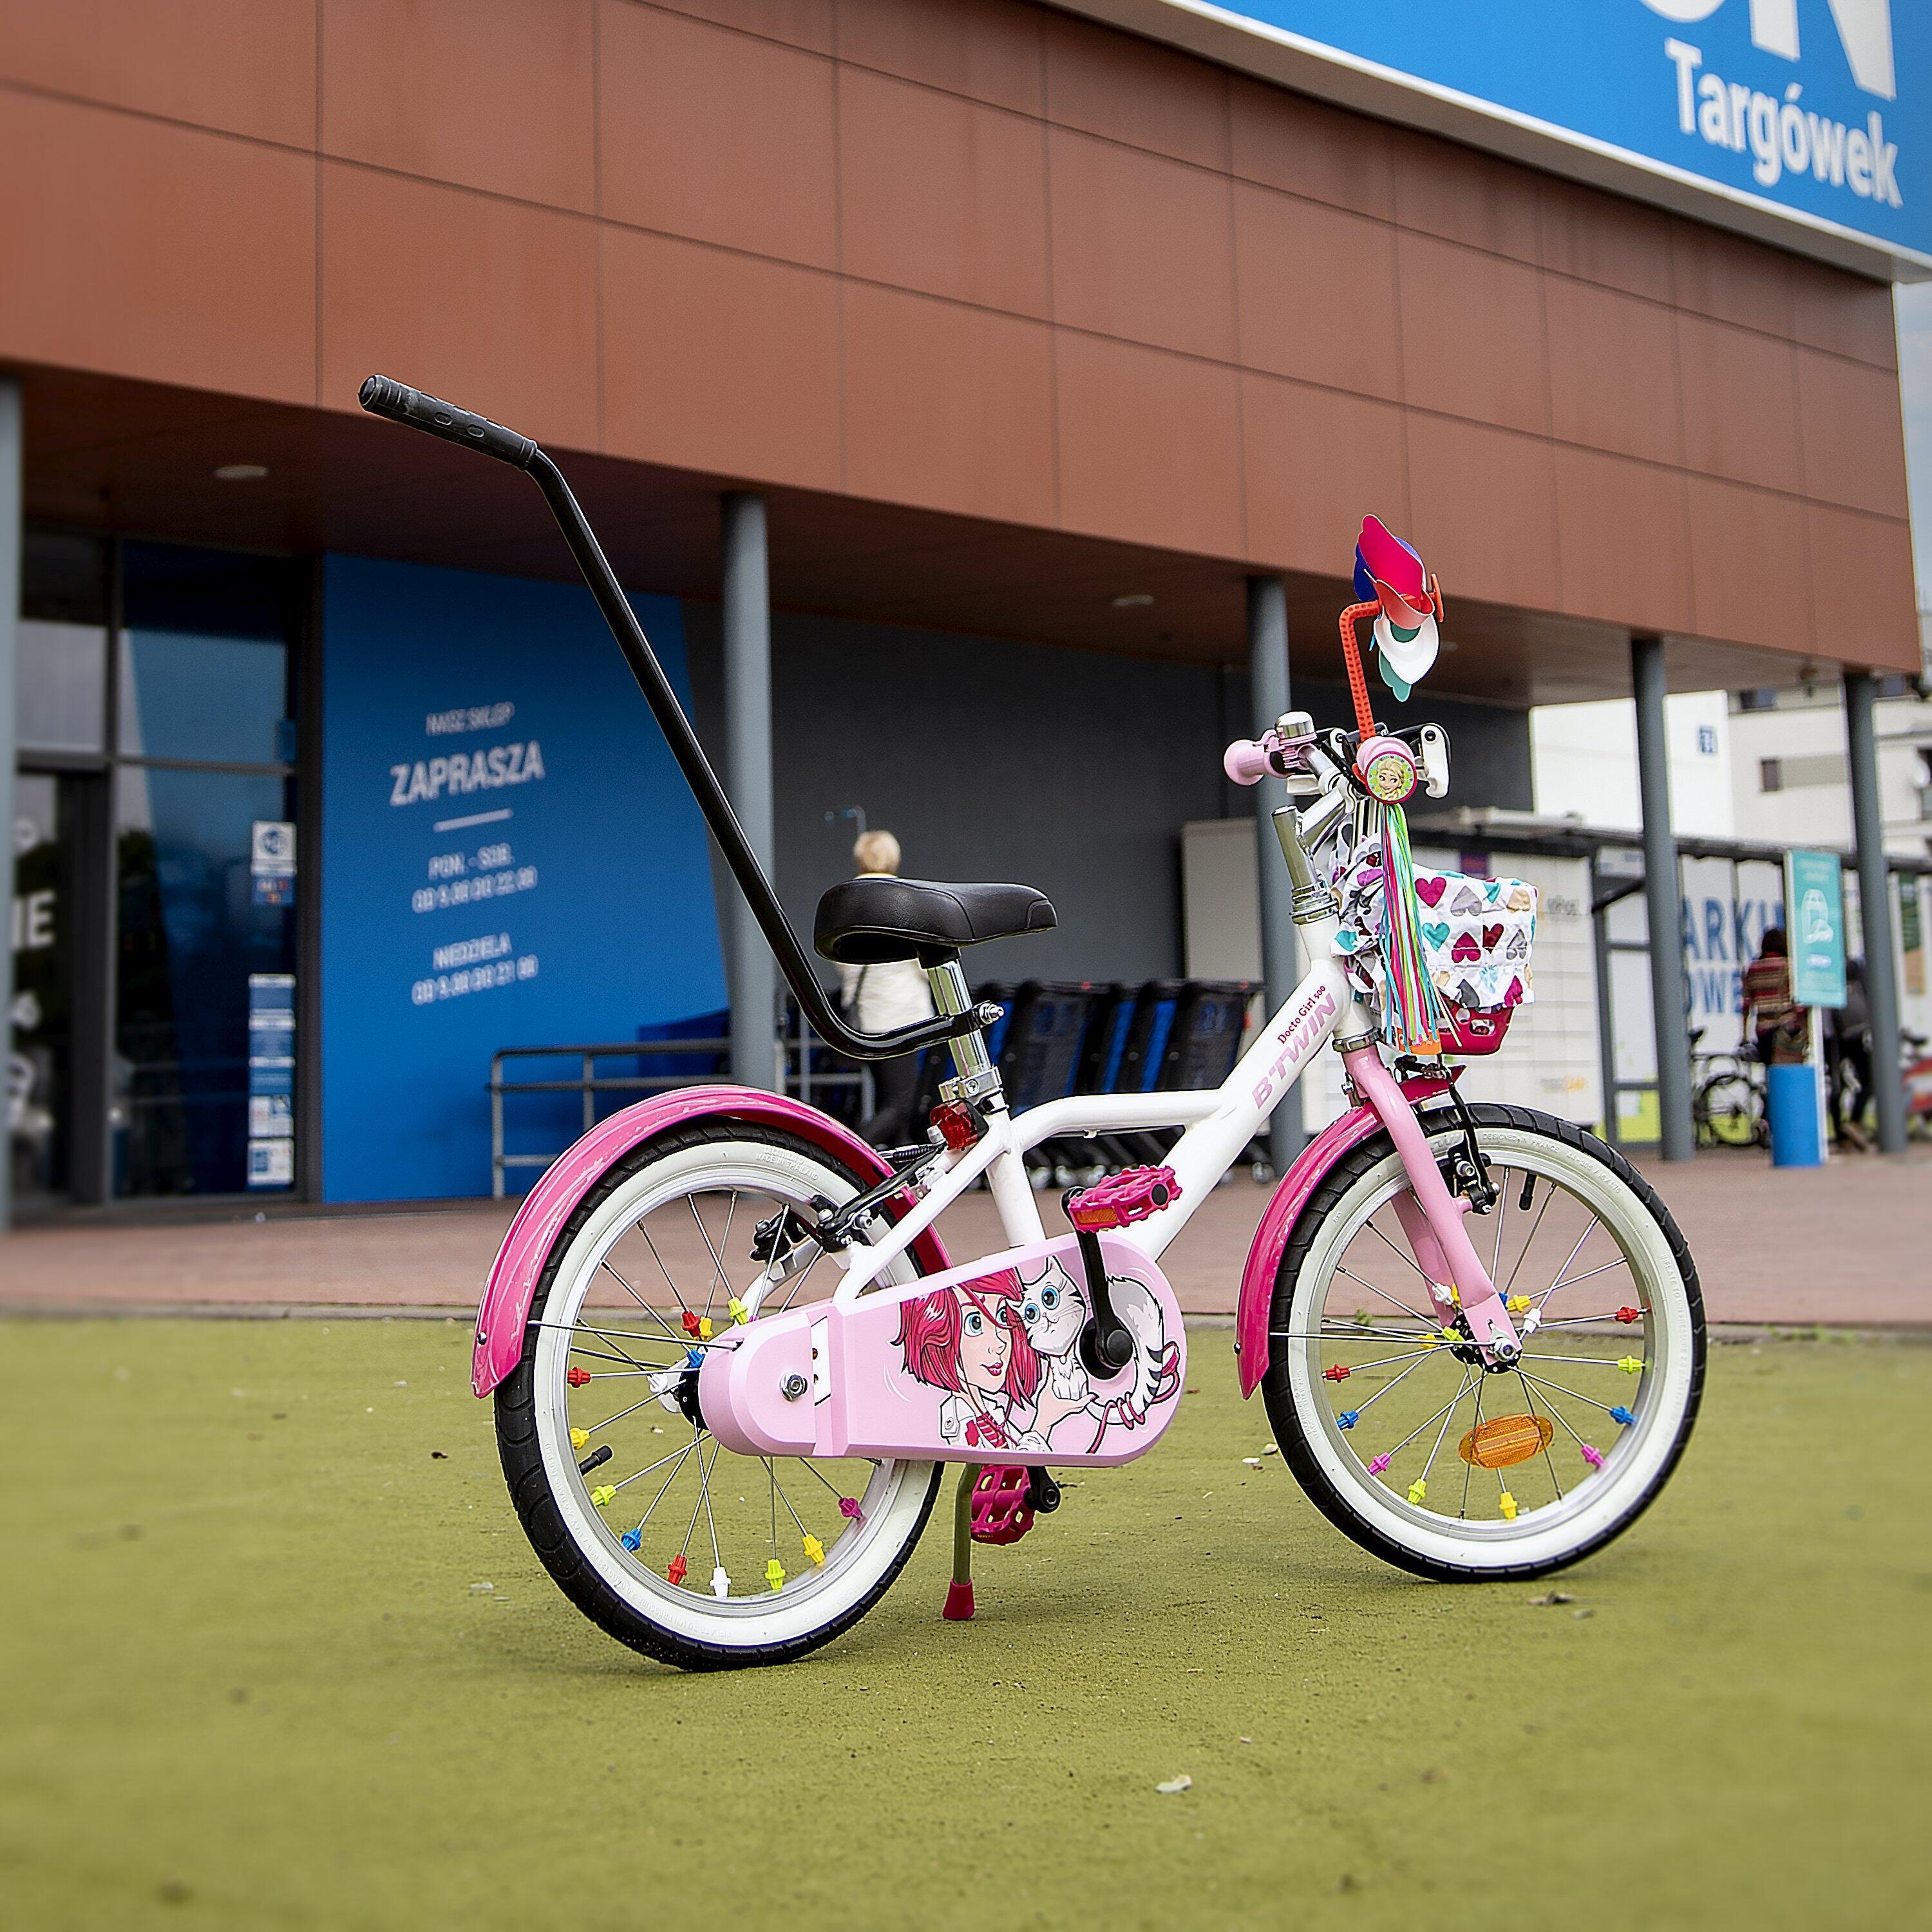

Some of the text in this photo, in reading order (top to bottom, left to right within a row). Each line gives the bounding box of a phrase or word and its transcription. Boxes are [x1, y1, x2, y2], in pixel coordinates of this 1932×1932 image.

[1664, 37, 1904, 209] Targówek
[390, 739, 546, 807] ZAPRASZA
[1277, 1016, 1301, 1044] Docto
[1298, 997, 1316, 1017] Girl
[1252, 992, 1336, 1110] B'TWIN
[786, 1160, 819, 1180] THAILAND
[1530, 1137, 1560, 1154] FRANCE
